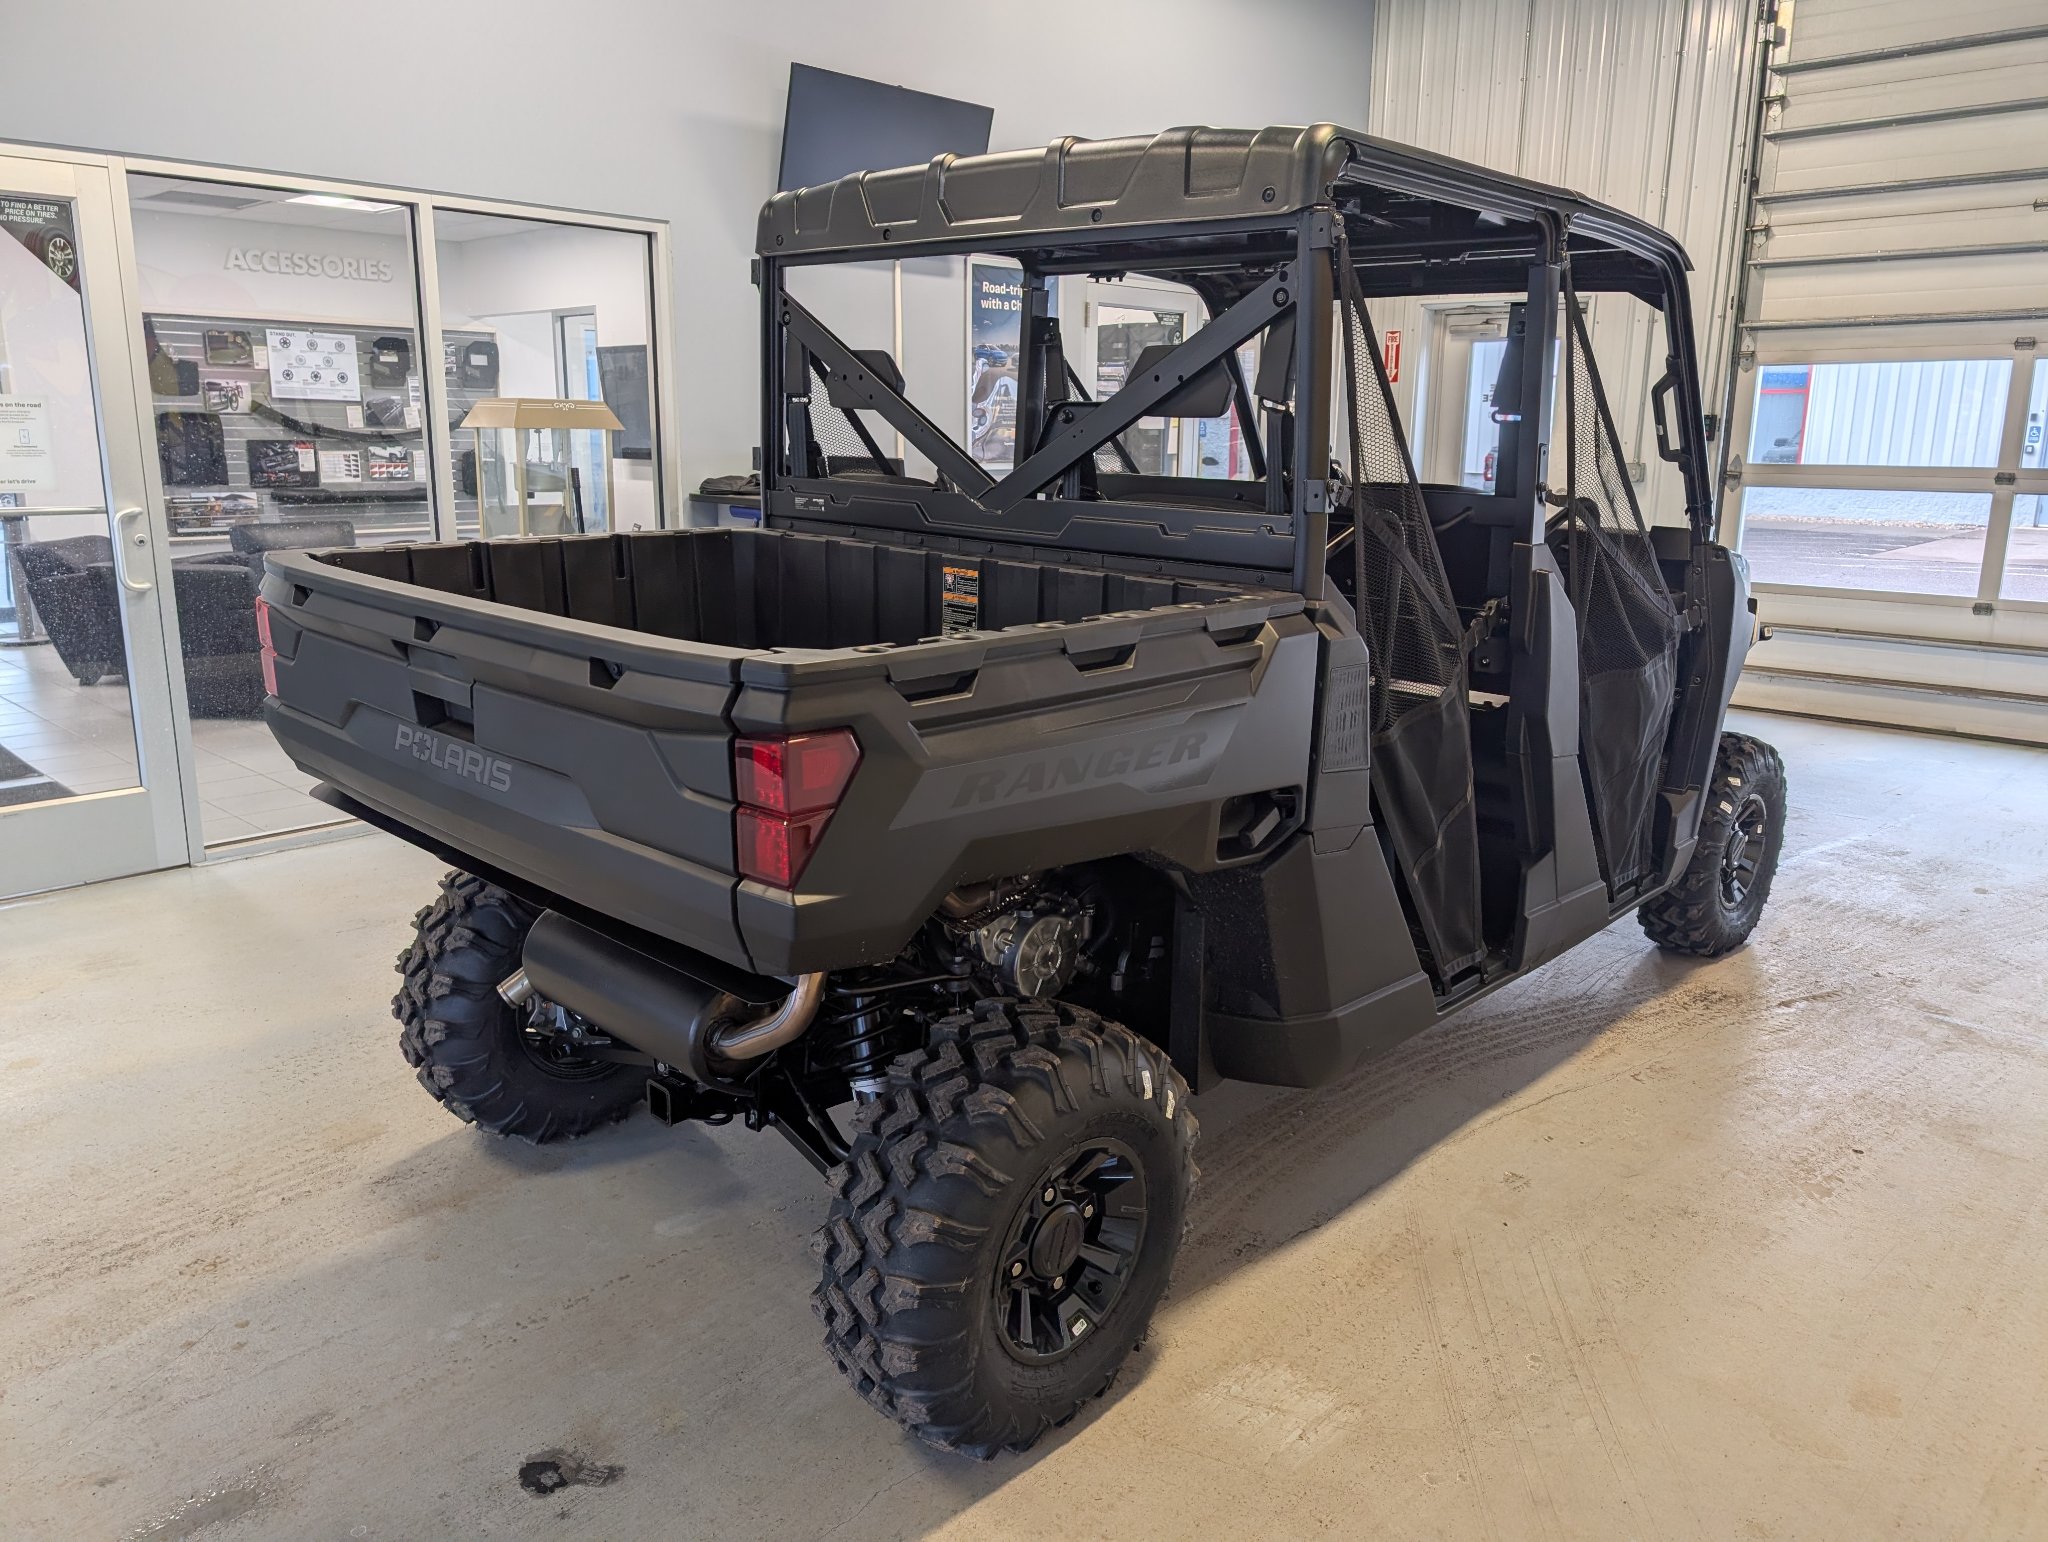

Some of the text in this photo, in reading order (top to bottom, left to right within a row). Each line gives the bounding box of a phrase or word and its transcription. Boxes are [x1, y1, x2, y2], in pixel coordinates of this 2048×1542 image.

[1, 200, 10, 208] TO
[11, 201, 26, 209] FIND
[34, 203, 59, 212] BETTER
[9, 215, 46, 224] PRESSURE.
[224, 247, 393, 283] ACCESSORIES
[980, 297, 1002, 310] with
[1003, 301, 1010, 311] a
[1387, 335, 1399, 343] FIRE
[394, 724, 513, 793] POLARIS
[951, 731, 1209, 809] RANGER
